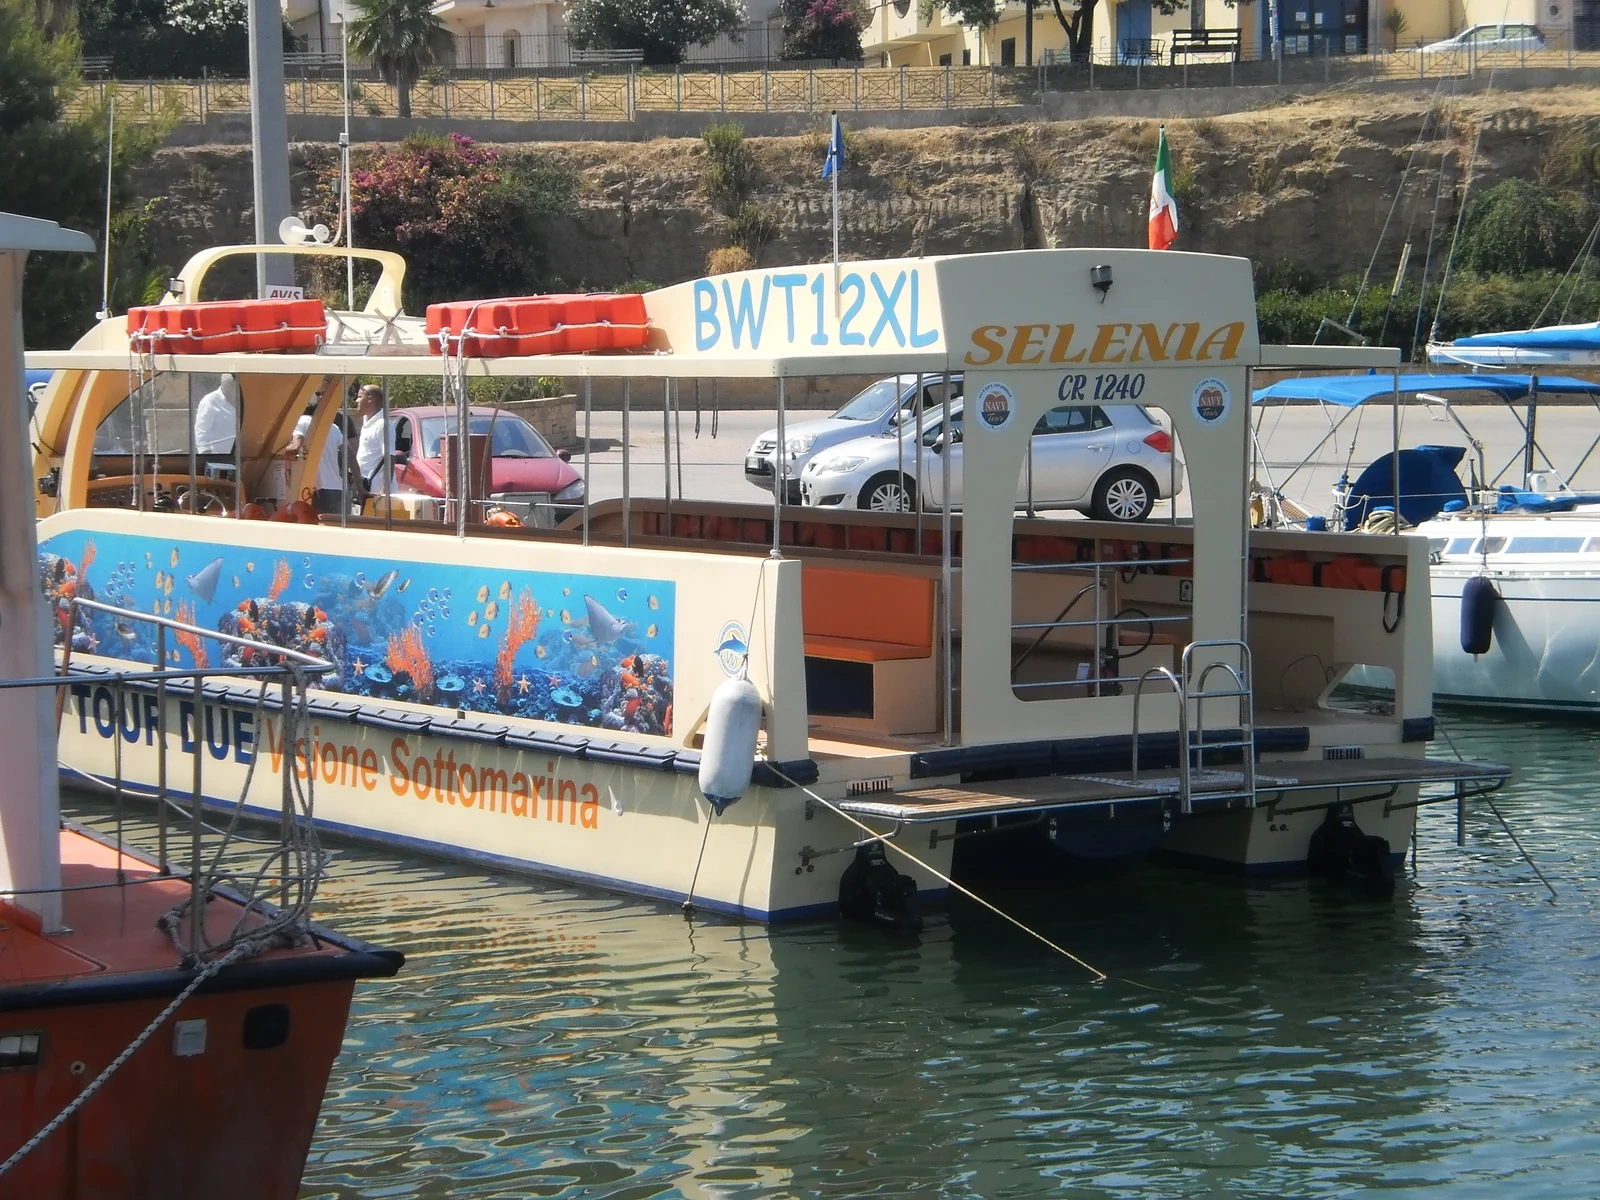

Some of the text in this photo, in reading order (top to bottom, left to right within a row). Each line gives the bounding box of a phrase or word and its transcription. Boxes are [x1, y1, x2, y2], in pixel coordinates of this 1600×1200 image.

[270, 290, 301, 300] AVIS
[693, 268, 940, 352] BWT12XL
[963, 321, 1246, 367] SELENIA
[1058, 373, 1146, 402] CR 1240
[1200, 396, 1222, 406] NAVY
[984, 401, 1007, 411] NAVY
[389, 737, 599, 830] Sottomarina
